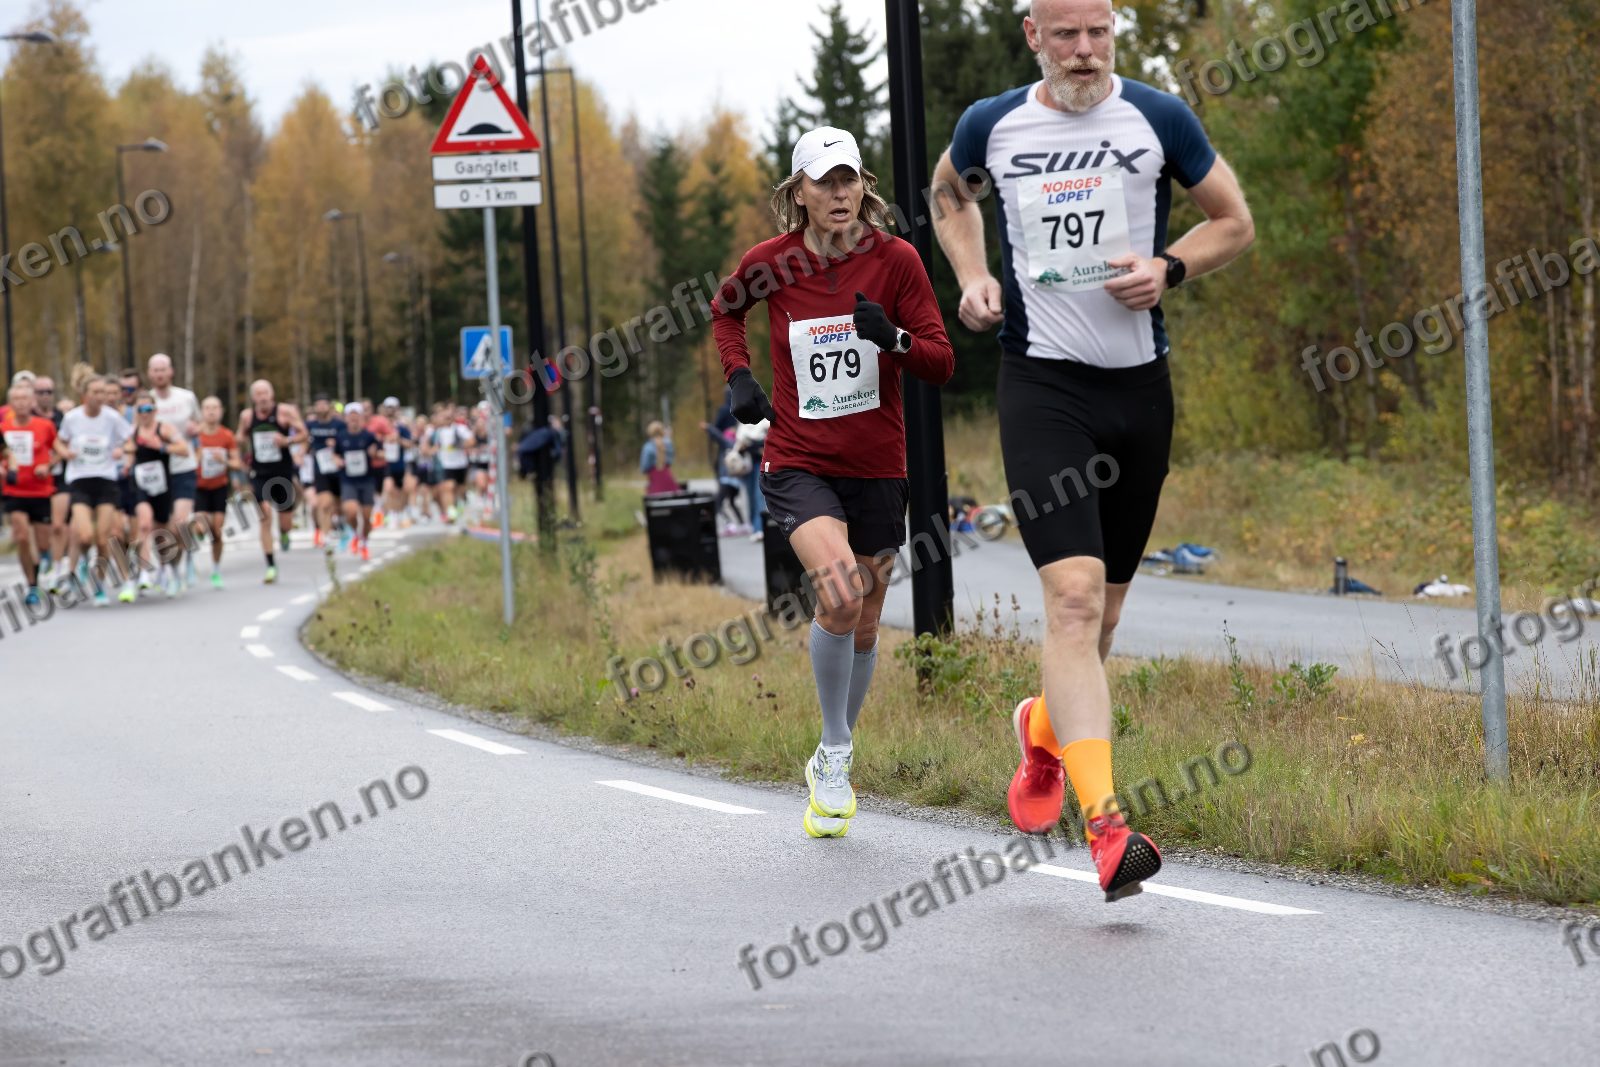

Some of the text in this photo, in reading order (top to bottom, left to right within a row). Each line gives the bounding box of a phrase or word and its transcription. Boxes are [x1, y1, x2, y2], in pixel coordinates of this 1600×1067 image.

[455, 160, 518, 176] Gangfelt
[1041, 176, 1103, 194] NORGES
[495, 187, 517, 201] km
[1047, 189, 1094, 206] LØPET
[1041, 209, 1105, 250] 797
[813, 332, 852, 345] LØPET
[809, 348, 861, 383] 679
[832, 389, 876, 405] Aurskog
